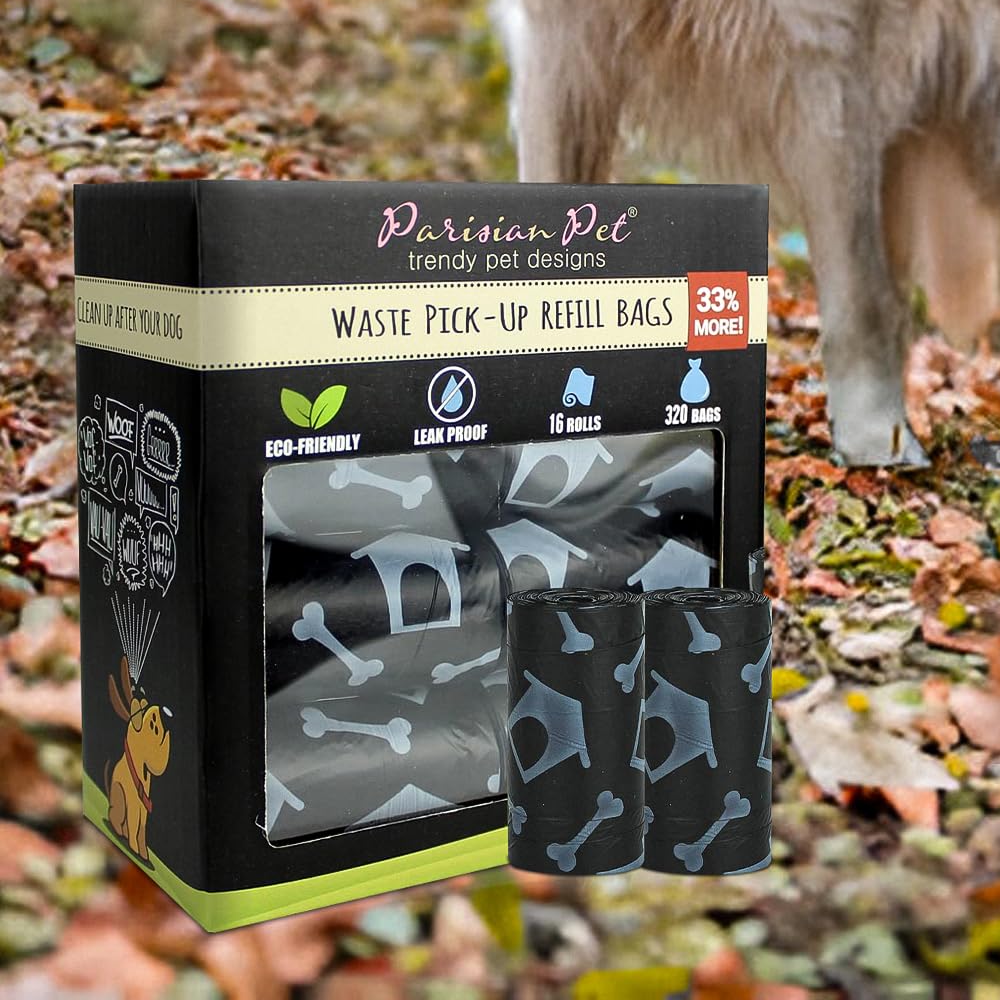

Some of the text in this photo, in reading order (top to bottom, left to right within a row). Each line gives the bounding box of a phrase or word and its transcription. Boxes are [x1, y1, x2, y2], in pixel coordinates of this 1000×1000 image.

[377, 201, 557, 249] Parisian
[408, 248, 606, 273] trendy pet designs
[696, 286, 740, 313] 33%
[77, 296, 183, 340] CLEAN UP AFTER YOUR DOG
[331, 297, 673, 339] WASTE PICK-UP REFILL BAGS
[694, 316, 744, 337] MORE!
[107, 410, 135, 439] WOOF
[549, 412, 602, 434] 16 ROLLS
[664, 404, 722, 425] 320 BAGS
[265, 433, 361, 458] ECO-FRIENDLY
[413, 423, 488, 446] LEAK PROOF
